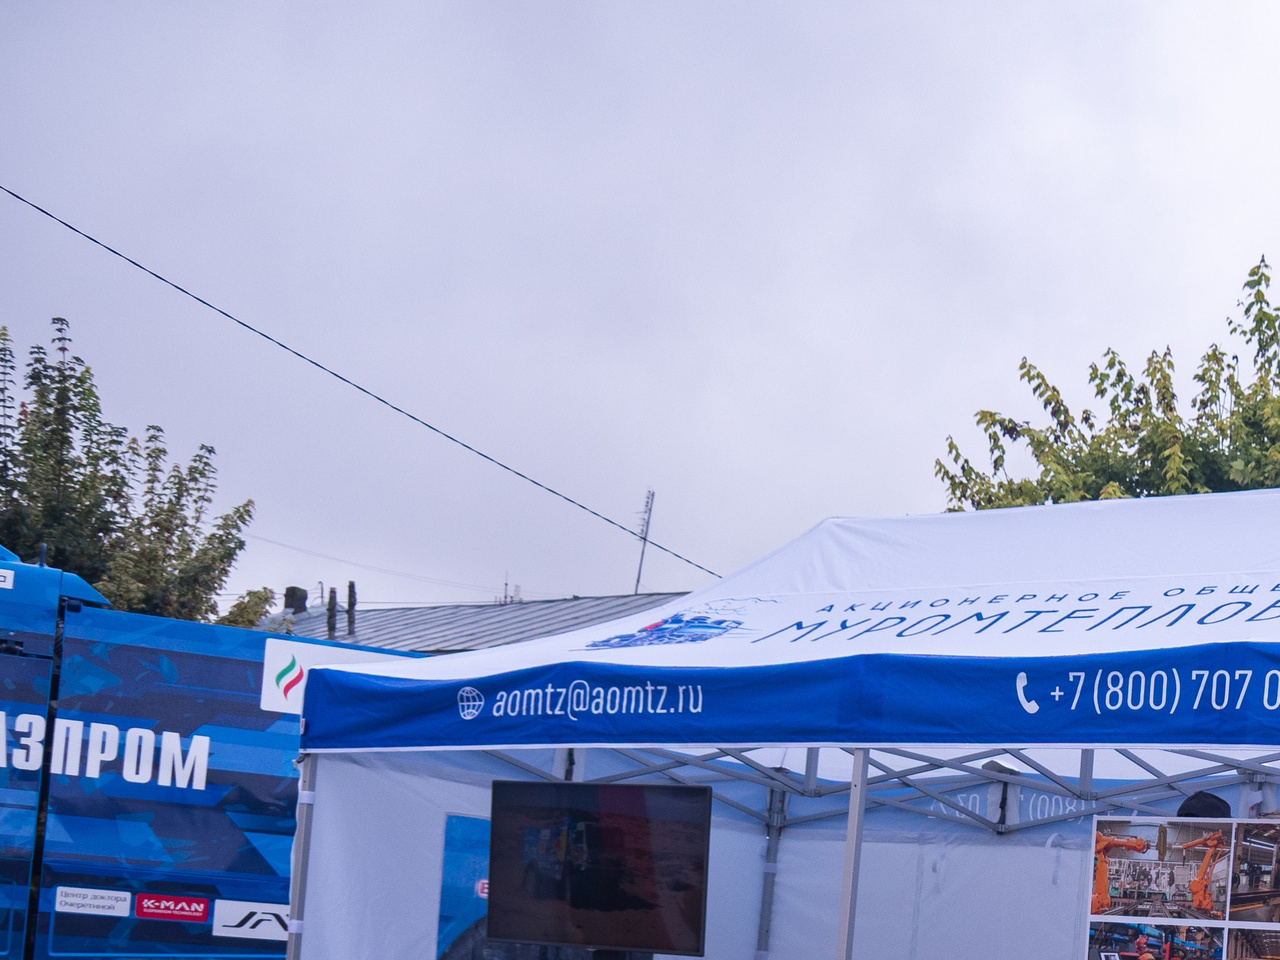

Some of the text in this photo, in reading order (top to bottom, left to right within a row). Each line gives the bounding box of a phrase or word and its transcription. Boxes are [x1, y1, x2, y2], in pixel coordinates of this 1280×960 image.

[816, 590, 1131, 613] АКЦИОНЕРНОЕ
[492, 680, 703, 721] aomtz@aomtz.ru
[1191, 670, 1253, 710] 707
[0, 711, 210, 790] ЗПРОМ
[142, 899, 205, 912] K-MAN
